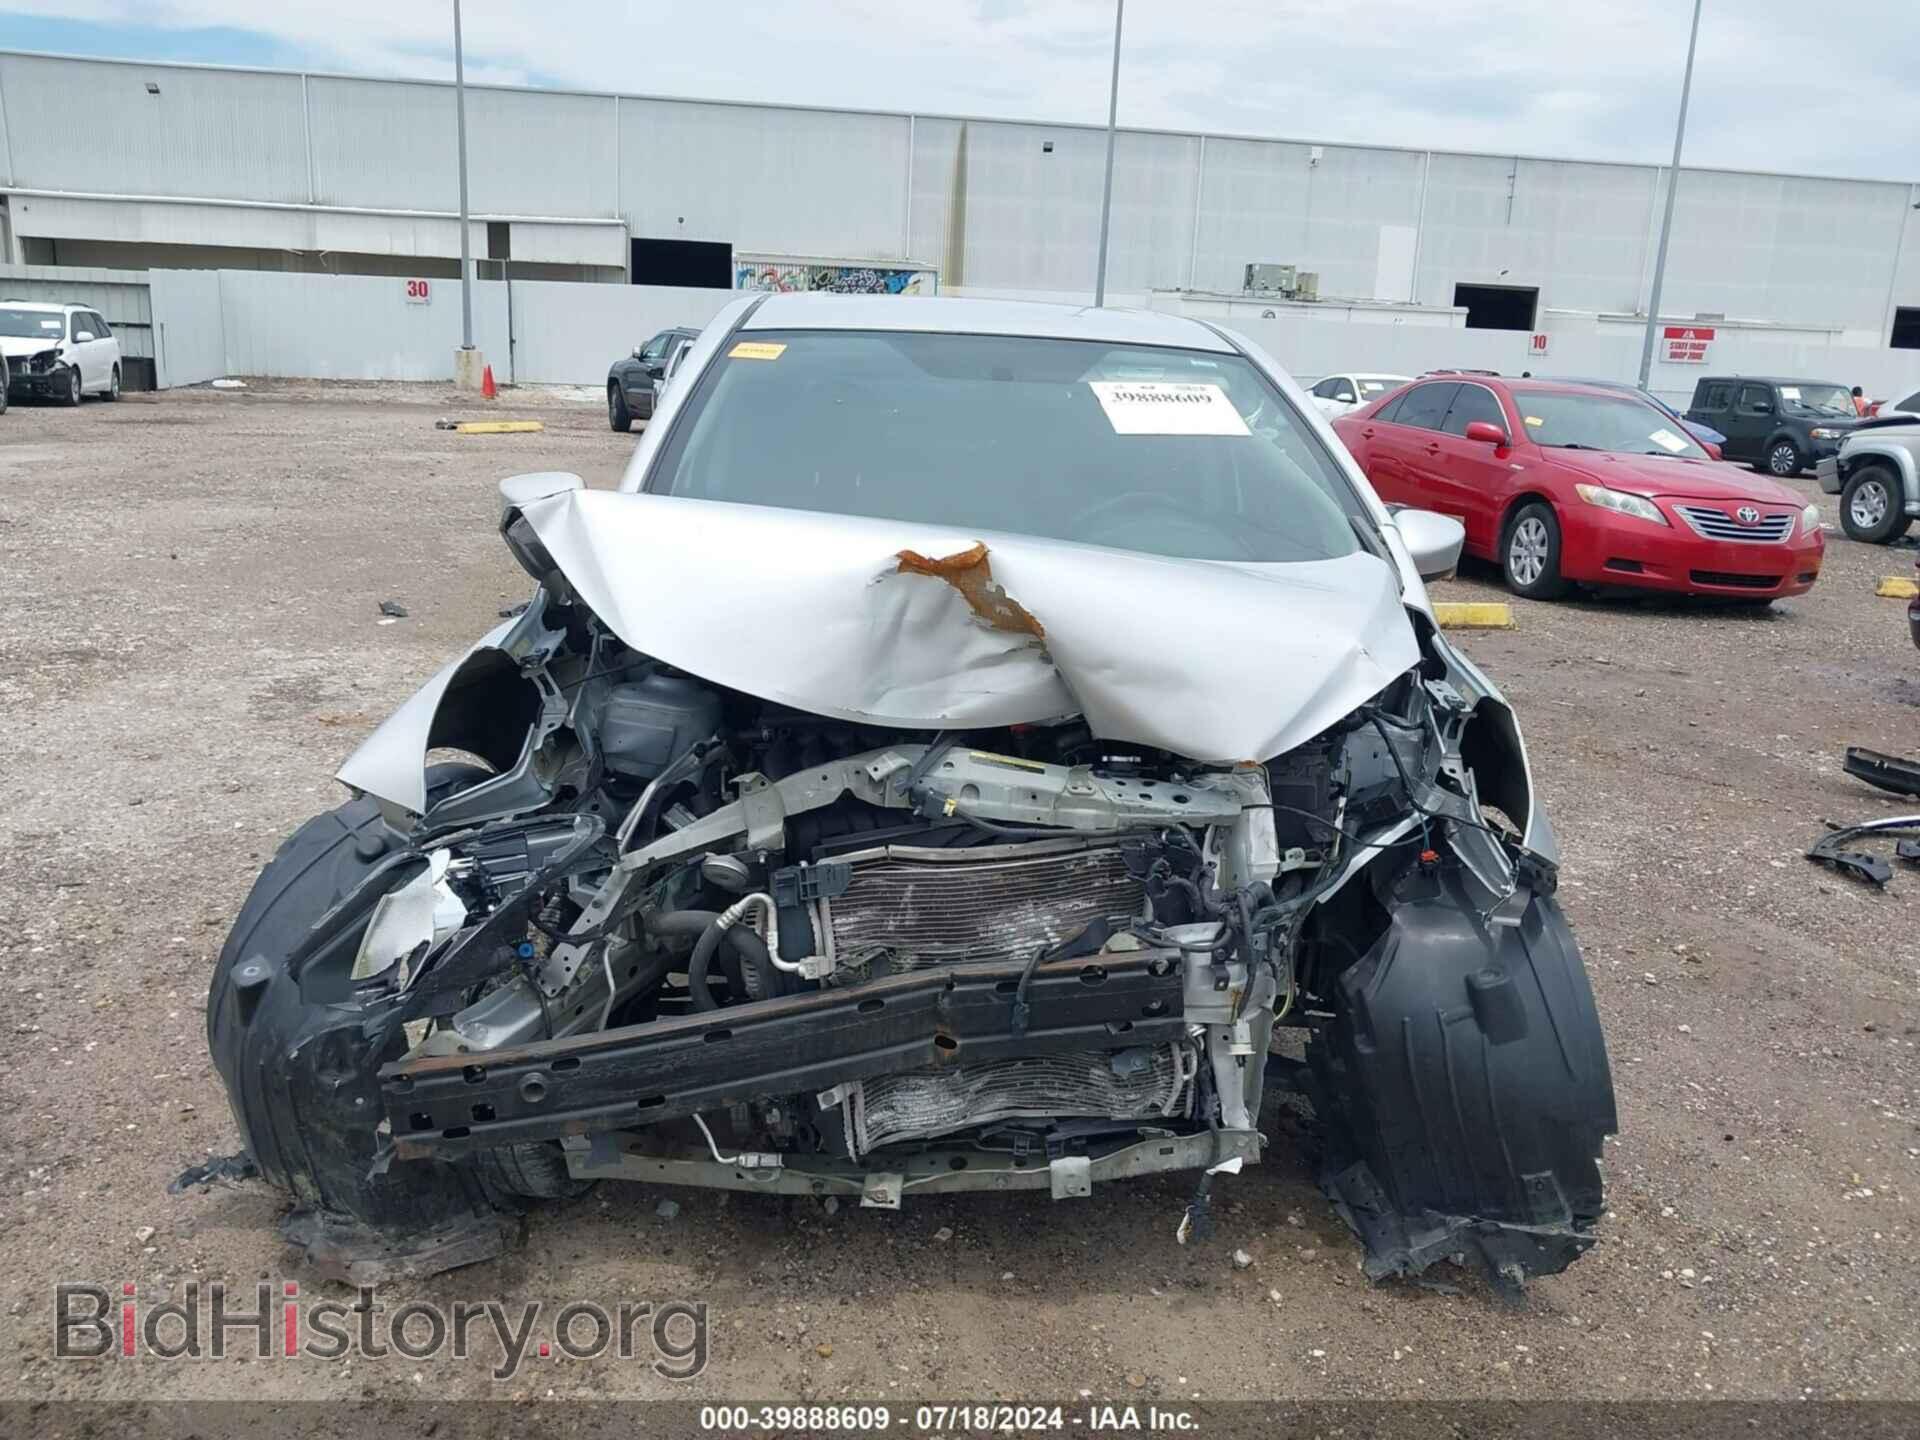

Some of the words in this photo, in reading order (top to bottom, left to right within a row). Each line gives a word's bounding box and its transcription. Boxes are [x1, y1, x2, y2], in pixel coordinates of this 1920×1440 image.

[407, 280, 428, 298] 30
[1532, 335, 1546, 350] 10
[1112, 391, 1213, 405] 39888609
